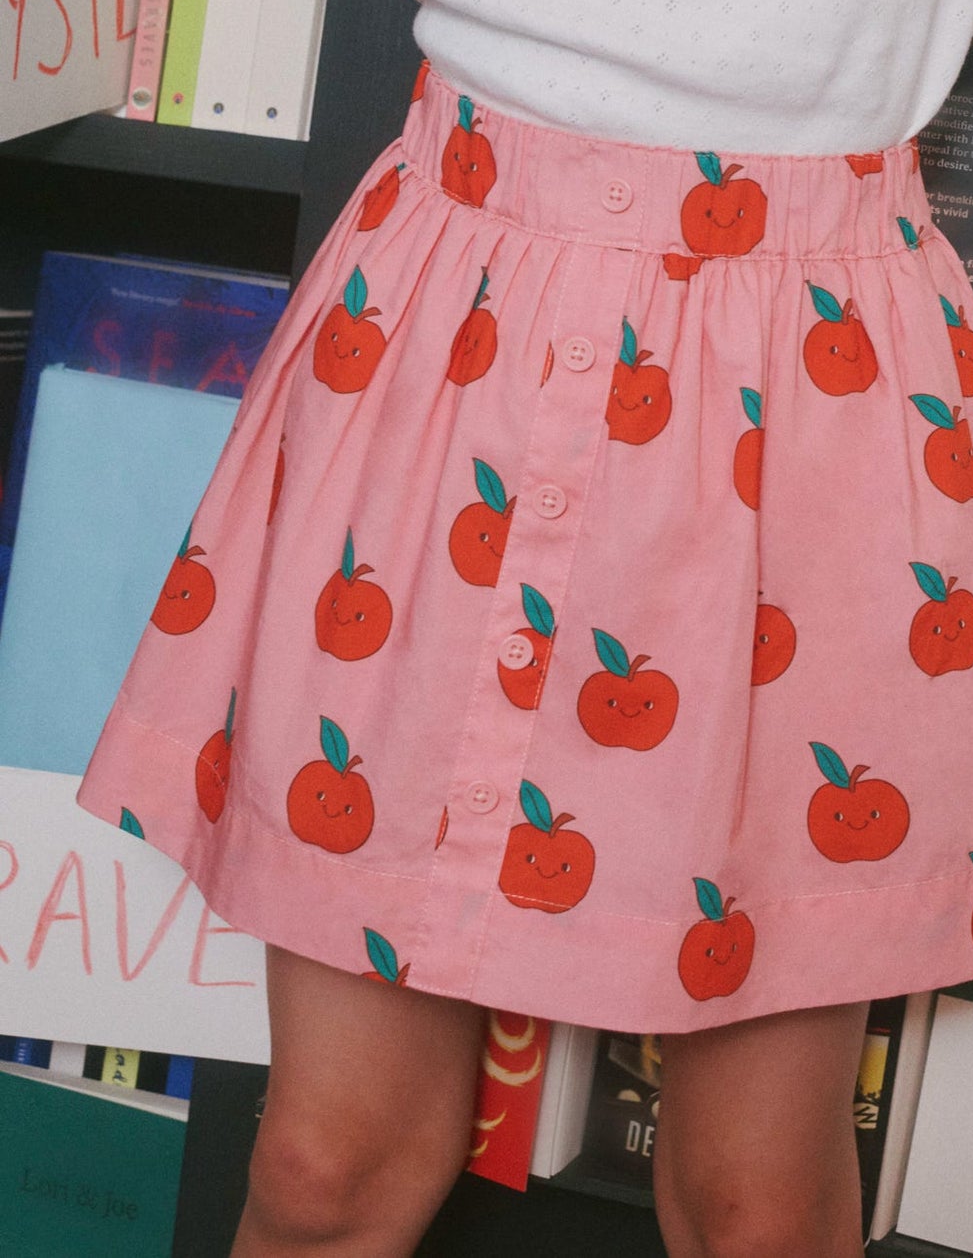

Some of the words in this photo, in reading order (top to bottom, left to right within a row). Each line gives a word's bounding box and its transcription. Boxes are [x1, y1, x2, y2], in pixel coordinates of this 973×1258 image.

[944, 132, 968, 143] with
[920, 144, 950, 155] ppeal
[953, 148, 968, 158] for
[924, 157, 935, 166] to
[937, 159, 973, 172] desire.
[943, 208, 968, 218] vivid
